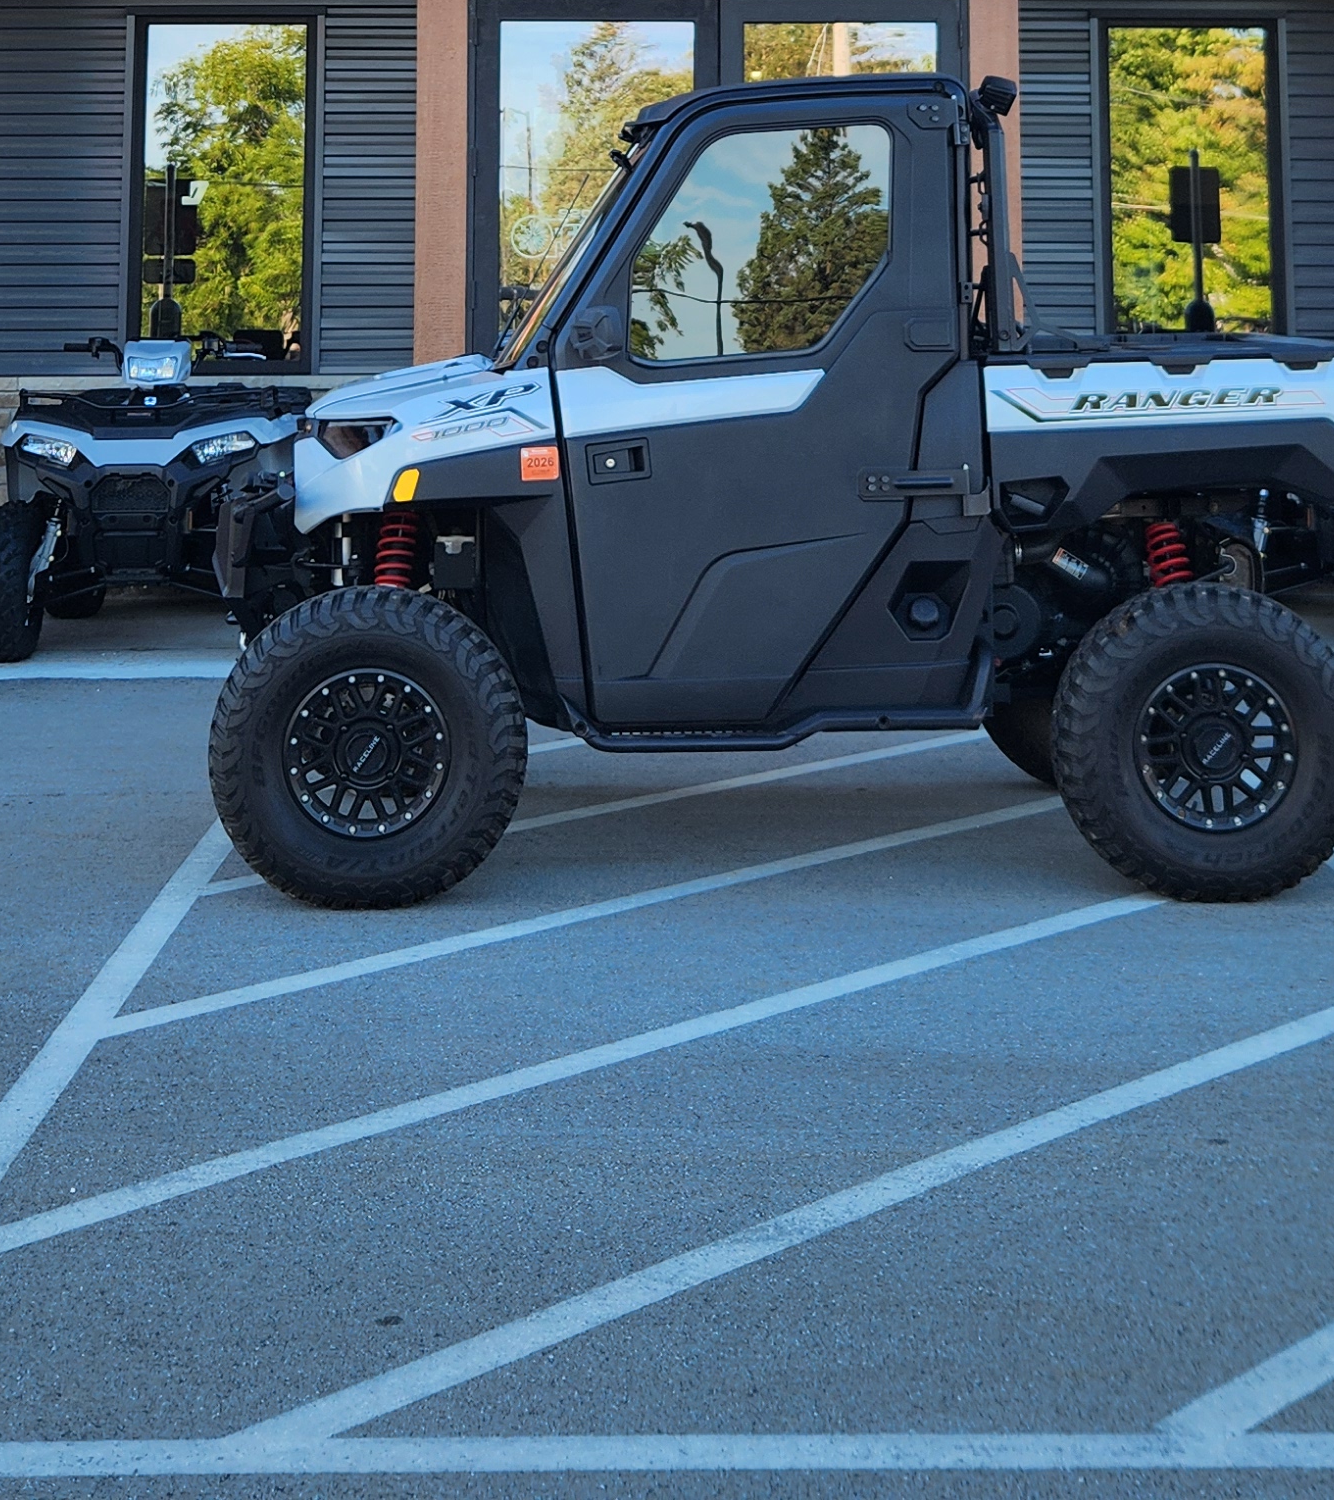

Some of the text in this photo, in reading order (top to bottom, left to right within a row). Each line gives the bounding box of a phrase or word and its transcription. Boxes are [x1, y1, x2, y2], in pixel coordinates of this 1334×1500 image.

[427, 381, 542, 421] XP
[1068, 385, 1284, 414] RANGER
[433, 415, 510, 441] 1000
[526, 457, 555, 468] 2026
[352, 735, 381, 773] RACELINE
[1202, 732, 1232, 766] RACELINE
